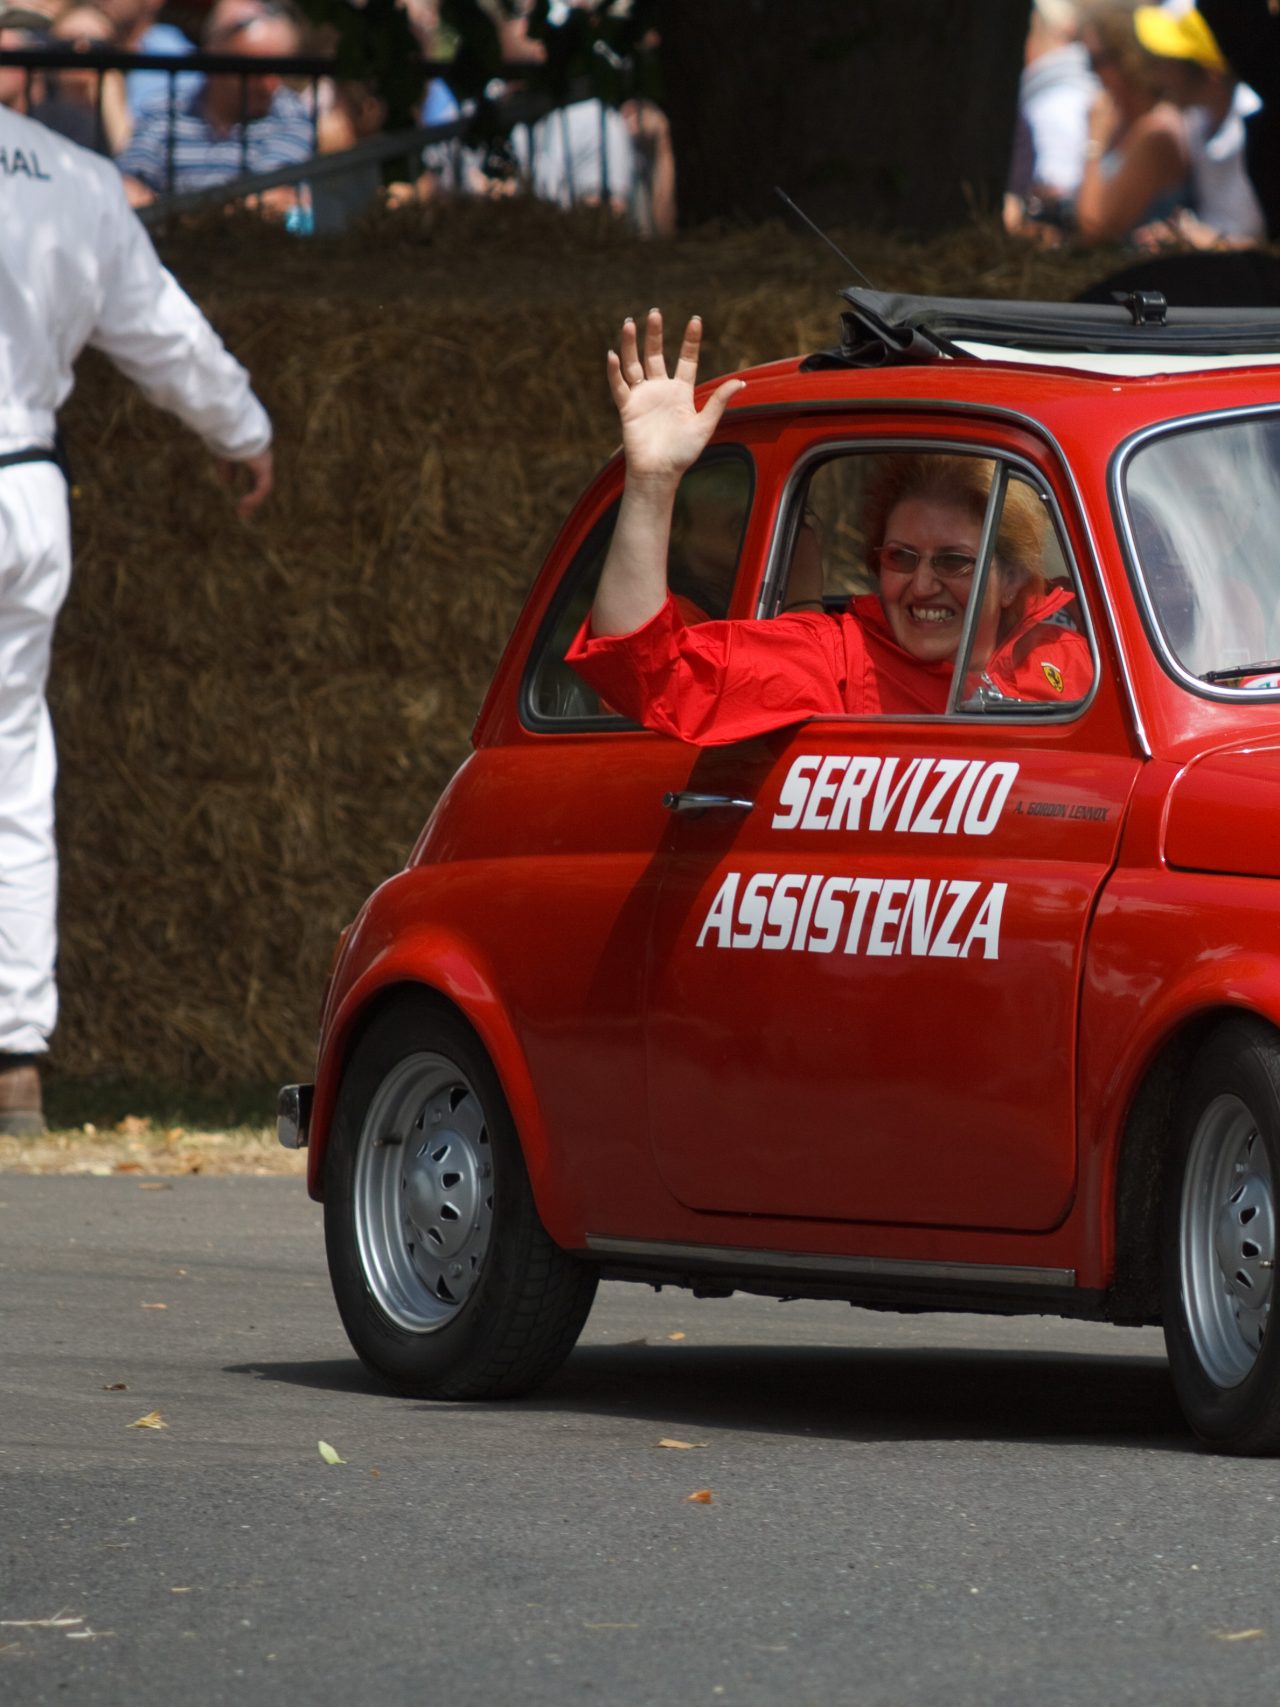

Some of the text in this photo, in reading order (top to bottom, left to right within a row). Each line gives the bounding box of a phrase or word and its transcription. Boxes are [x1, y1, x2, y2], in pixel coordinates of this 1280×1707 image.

[771, 755, 1020, 836] SERVIZIO
[1026, 801, 1068, 818] GORDON
[1068, 804, 1110, 822] LENNOX
[695, 871, 1009, 960] ASSISTENZA
